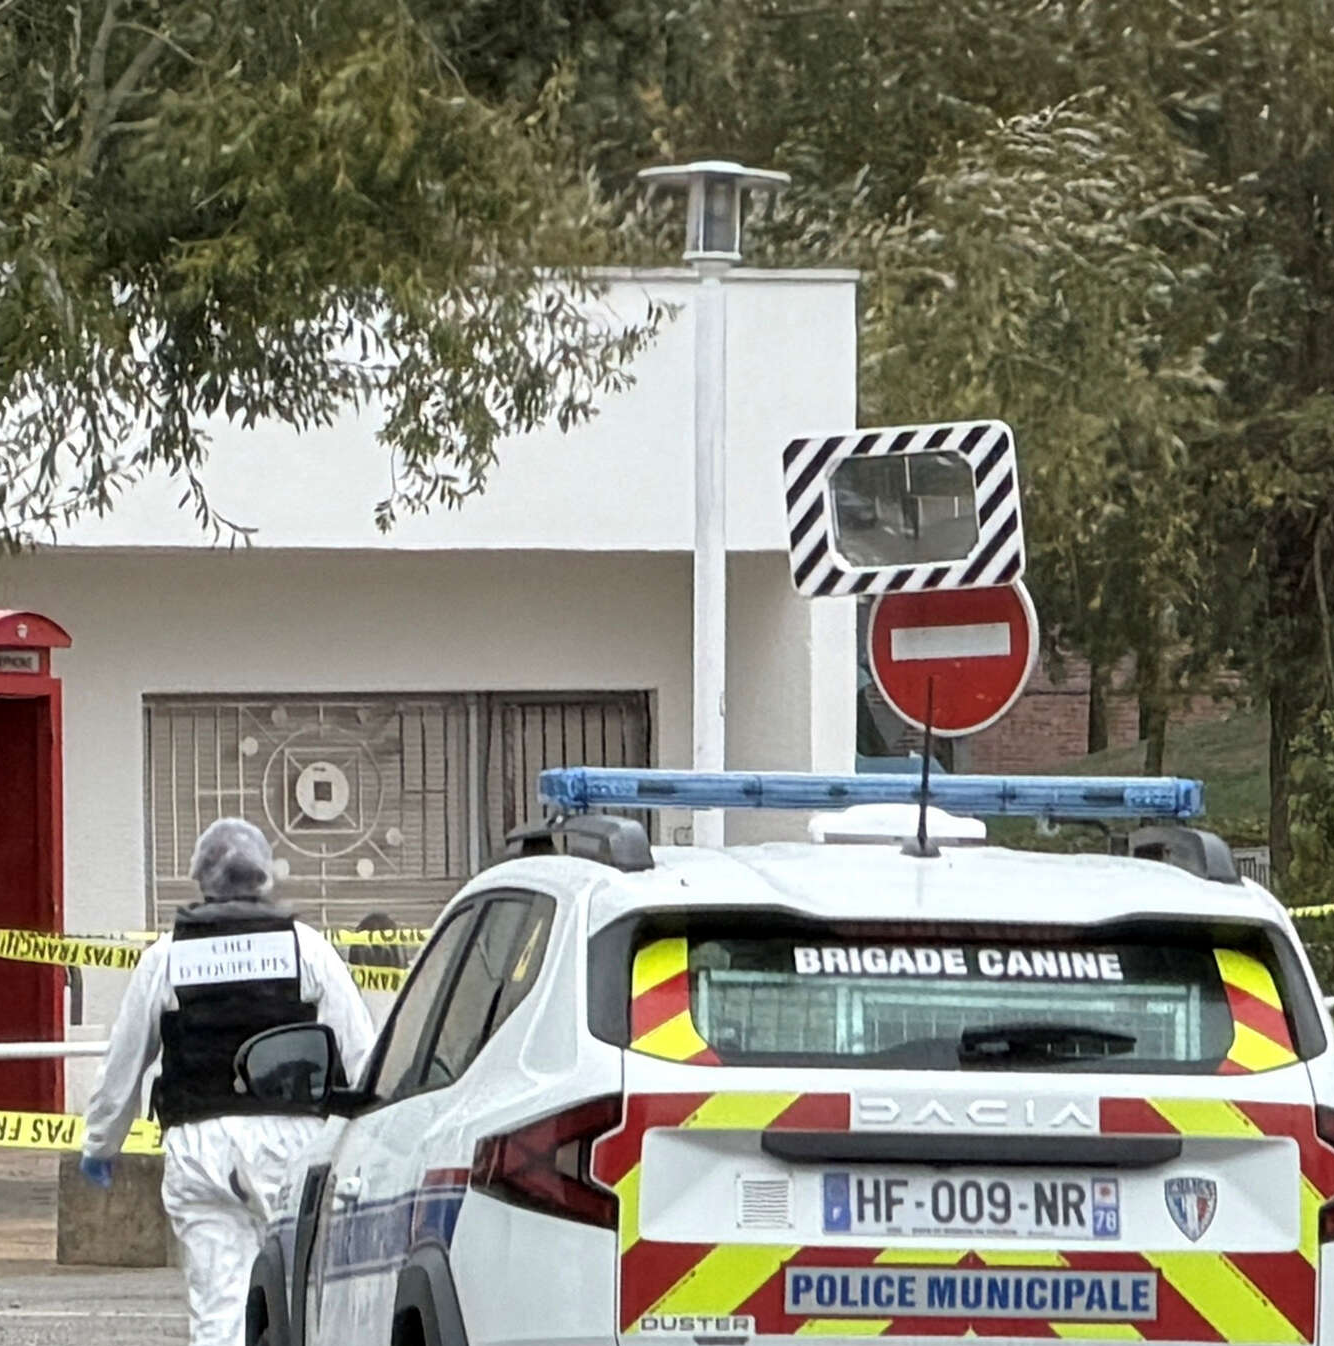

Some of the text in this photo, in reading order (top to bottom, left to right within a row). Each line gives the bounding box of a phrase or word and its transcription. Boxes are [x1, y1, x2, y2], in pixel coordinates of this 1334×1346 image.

[794, 947, 1123, 980] BRIGADE CANINE
[859, 1097, 1093, 1128] DACIA
[31, 1118, 75, 1143] PAS
[856, 1178, 1087, 1226] HF-009-NR
[1094, 1209, 1117, 1232] 78
[791, 1273, 1150, 1313] POLICE MUNICIPALE
[641, 1315, 750, 1331] DUSTER
